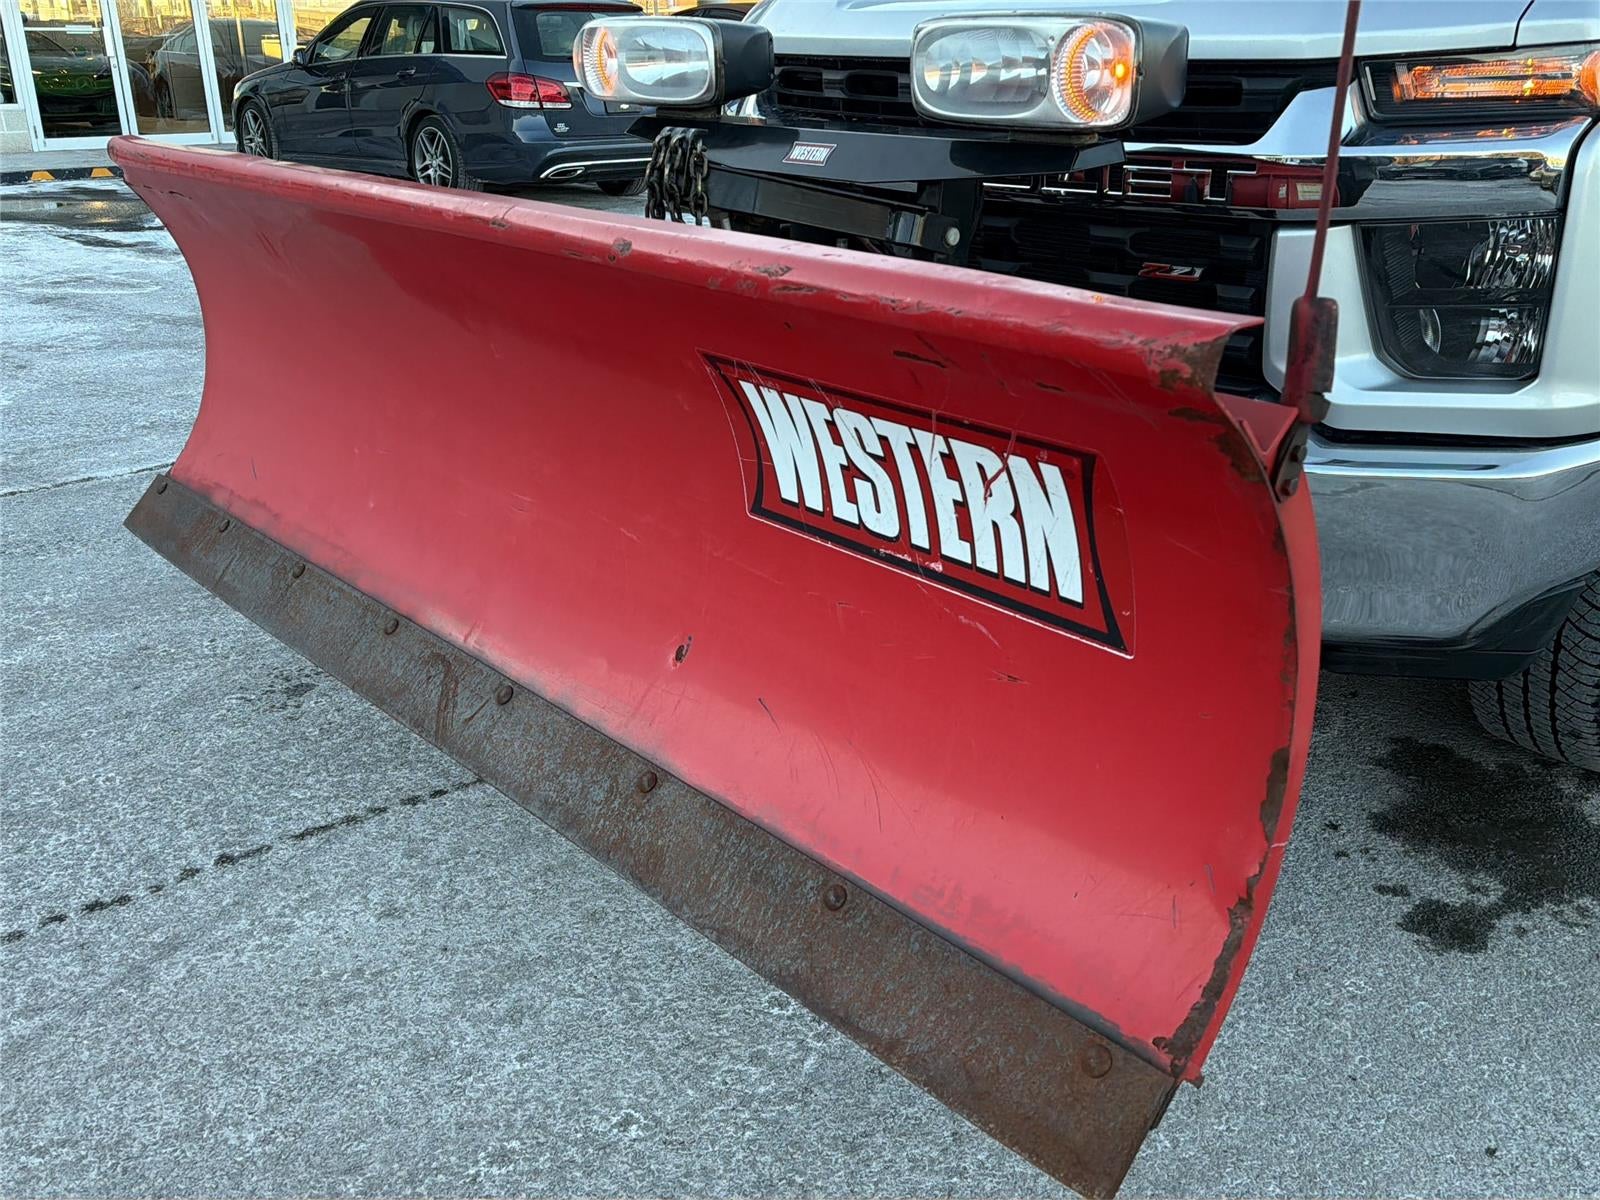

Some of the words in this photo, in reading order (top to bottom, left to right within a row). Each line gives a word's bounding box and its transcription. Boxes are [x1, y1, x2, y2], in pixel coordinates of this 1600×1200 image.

[789, 145, 831, 162] WESTERN
[1137, 262, 1204, 281] Z71
[738, 379, 1083, 606] WESTERN
